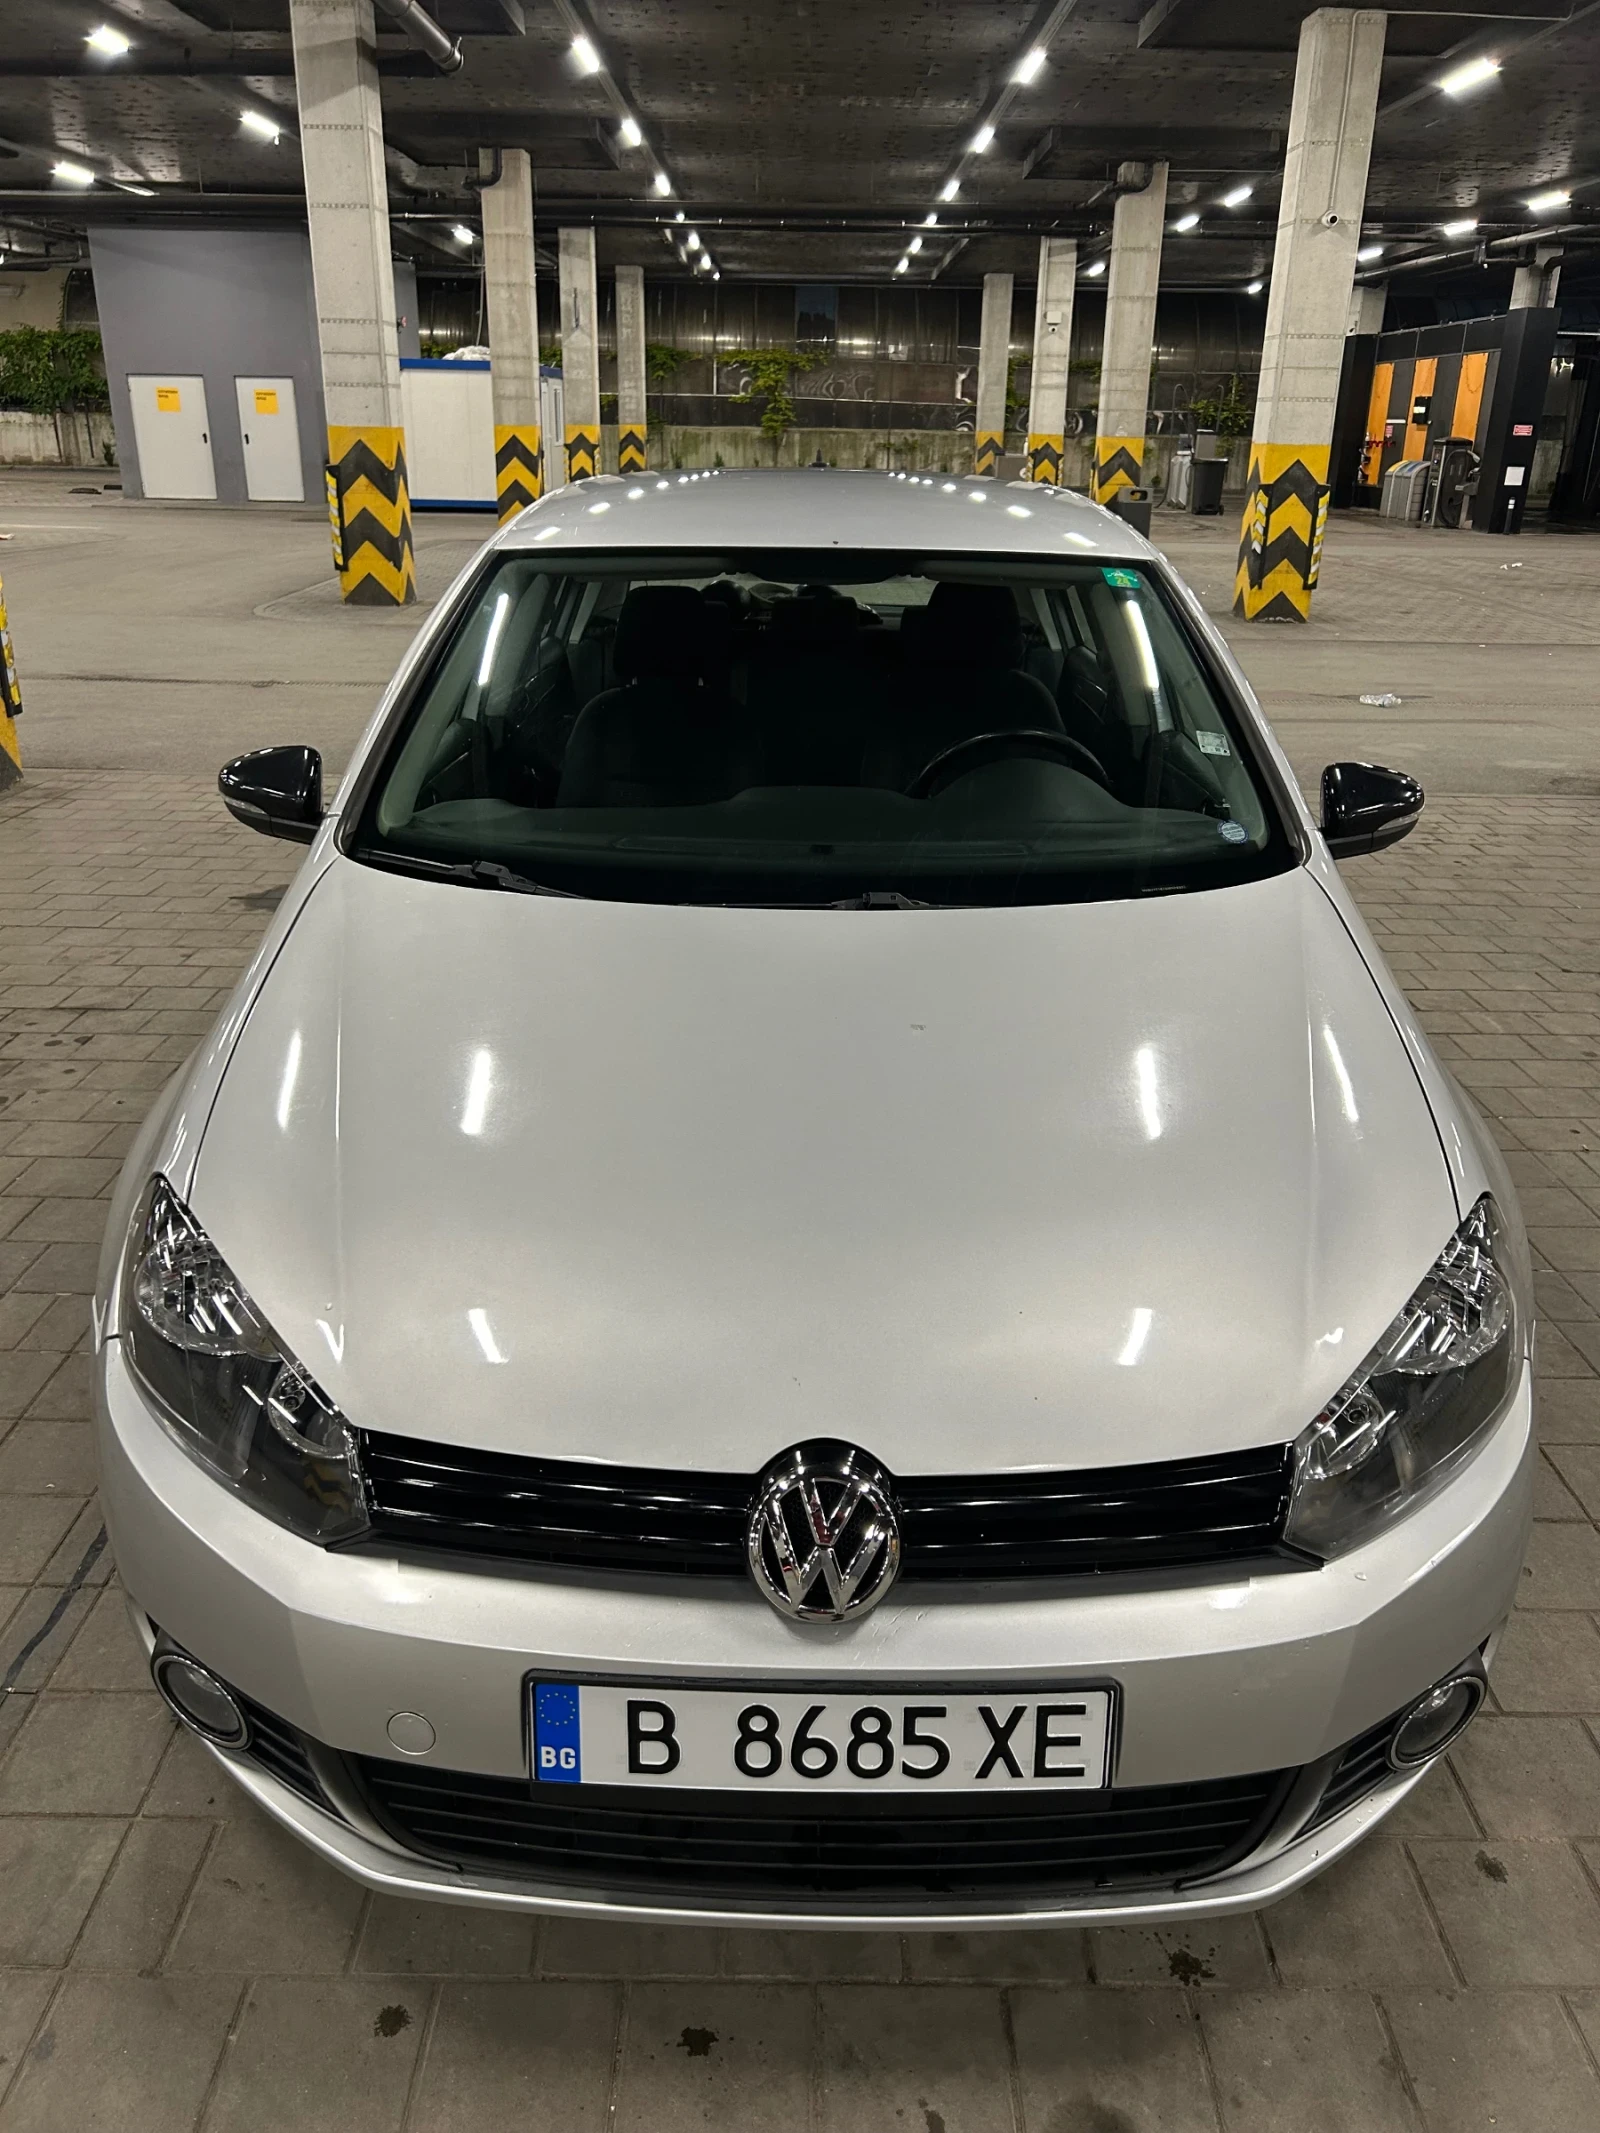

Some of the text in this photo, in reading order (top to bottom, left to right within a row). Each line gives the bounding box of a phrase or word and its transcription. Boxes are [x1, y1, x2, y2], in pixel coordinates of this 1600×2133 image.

[754, 1474, 897, 1617] VW
[541, 1746, 576, 1769] BG
[627, 1699, 1087, 1779] B 8685 XE
